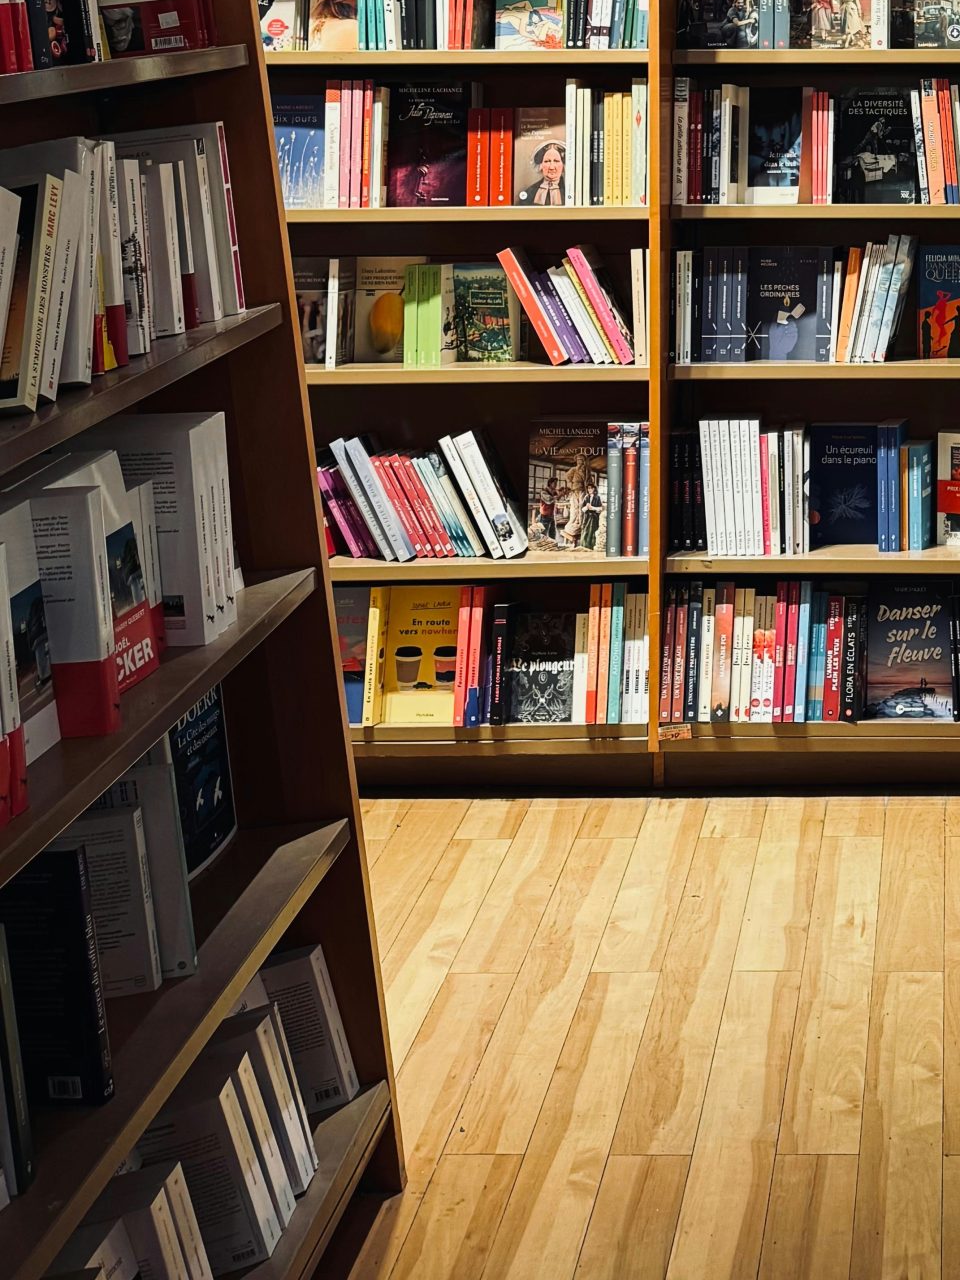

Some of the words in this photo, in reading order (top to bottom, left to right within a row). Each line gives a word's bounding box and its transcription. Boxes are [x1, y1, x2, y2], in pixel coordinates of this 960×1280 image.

[852, 100, 863, 108] LA
[864, 99, 904, 108] DIVERSITÉ
[865, 107, 908, 116] TACTIQUES
[49, 183, 60, 214] LEVY
[925, 254, 947, 262] FELICIA
[773, 283, 800, 291] PÉCHÉS
[32, 320, 45, 371] SYMPHONIE
[40, 244, 52, 297] MONSTRES
[538, 427, 563, 436] MICHEL
[563, 427, 601, 436] LANGLOIS
[542, 446, 560, 456] VIE
[577, 446, 606, 456] TOUT
[825, 445, 839, 454] Un
[840, 445, 873, 454] écureuil
[821, 455, 842, 464] dans
[843, 455, 852, 464] le
[853, 456, 877, 466] piano
[952, 448, 960, 464] RUE
[876, 603, 943, 623] Danser
[412, 619, 423, 627] En
[424, 618, 451, 627] route
[399, 628, 419, 636] vers
[421, 627, 458, 636] nowher
[886, 627, 920, 644] sur
[920, 620, 938, 640] le
[848, 631, 857, 662] ÉCLATS
[886, 644, 943, 668] fleuve
[845, 676, 854, 703] FLORA
